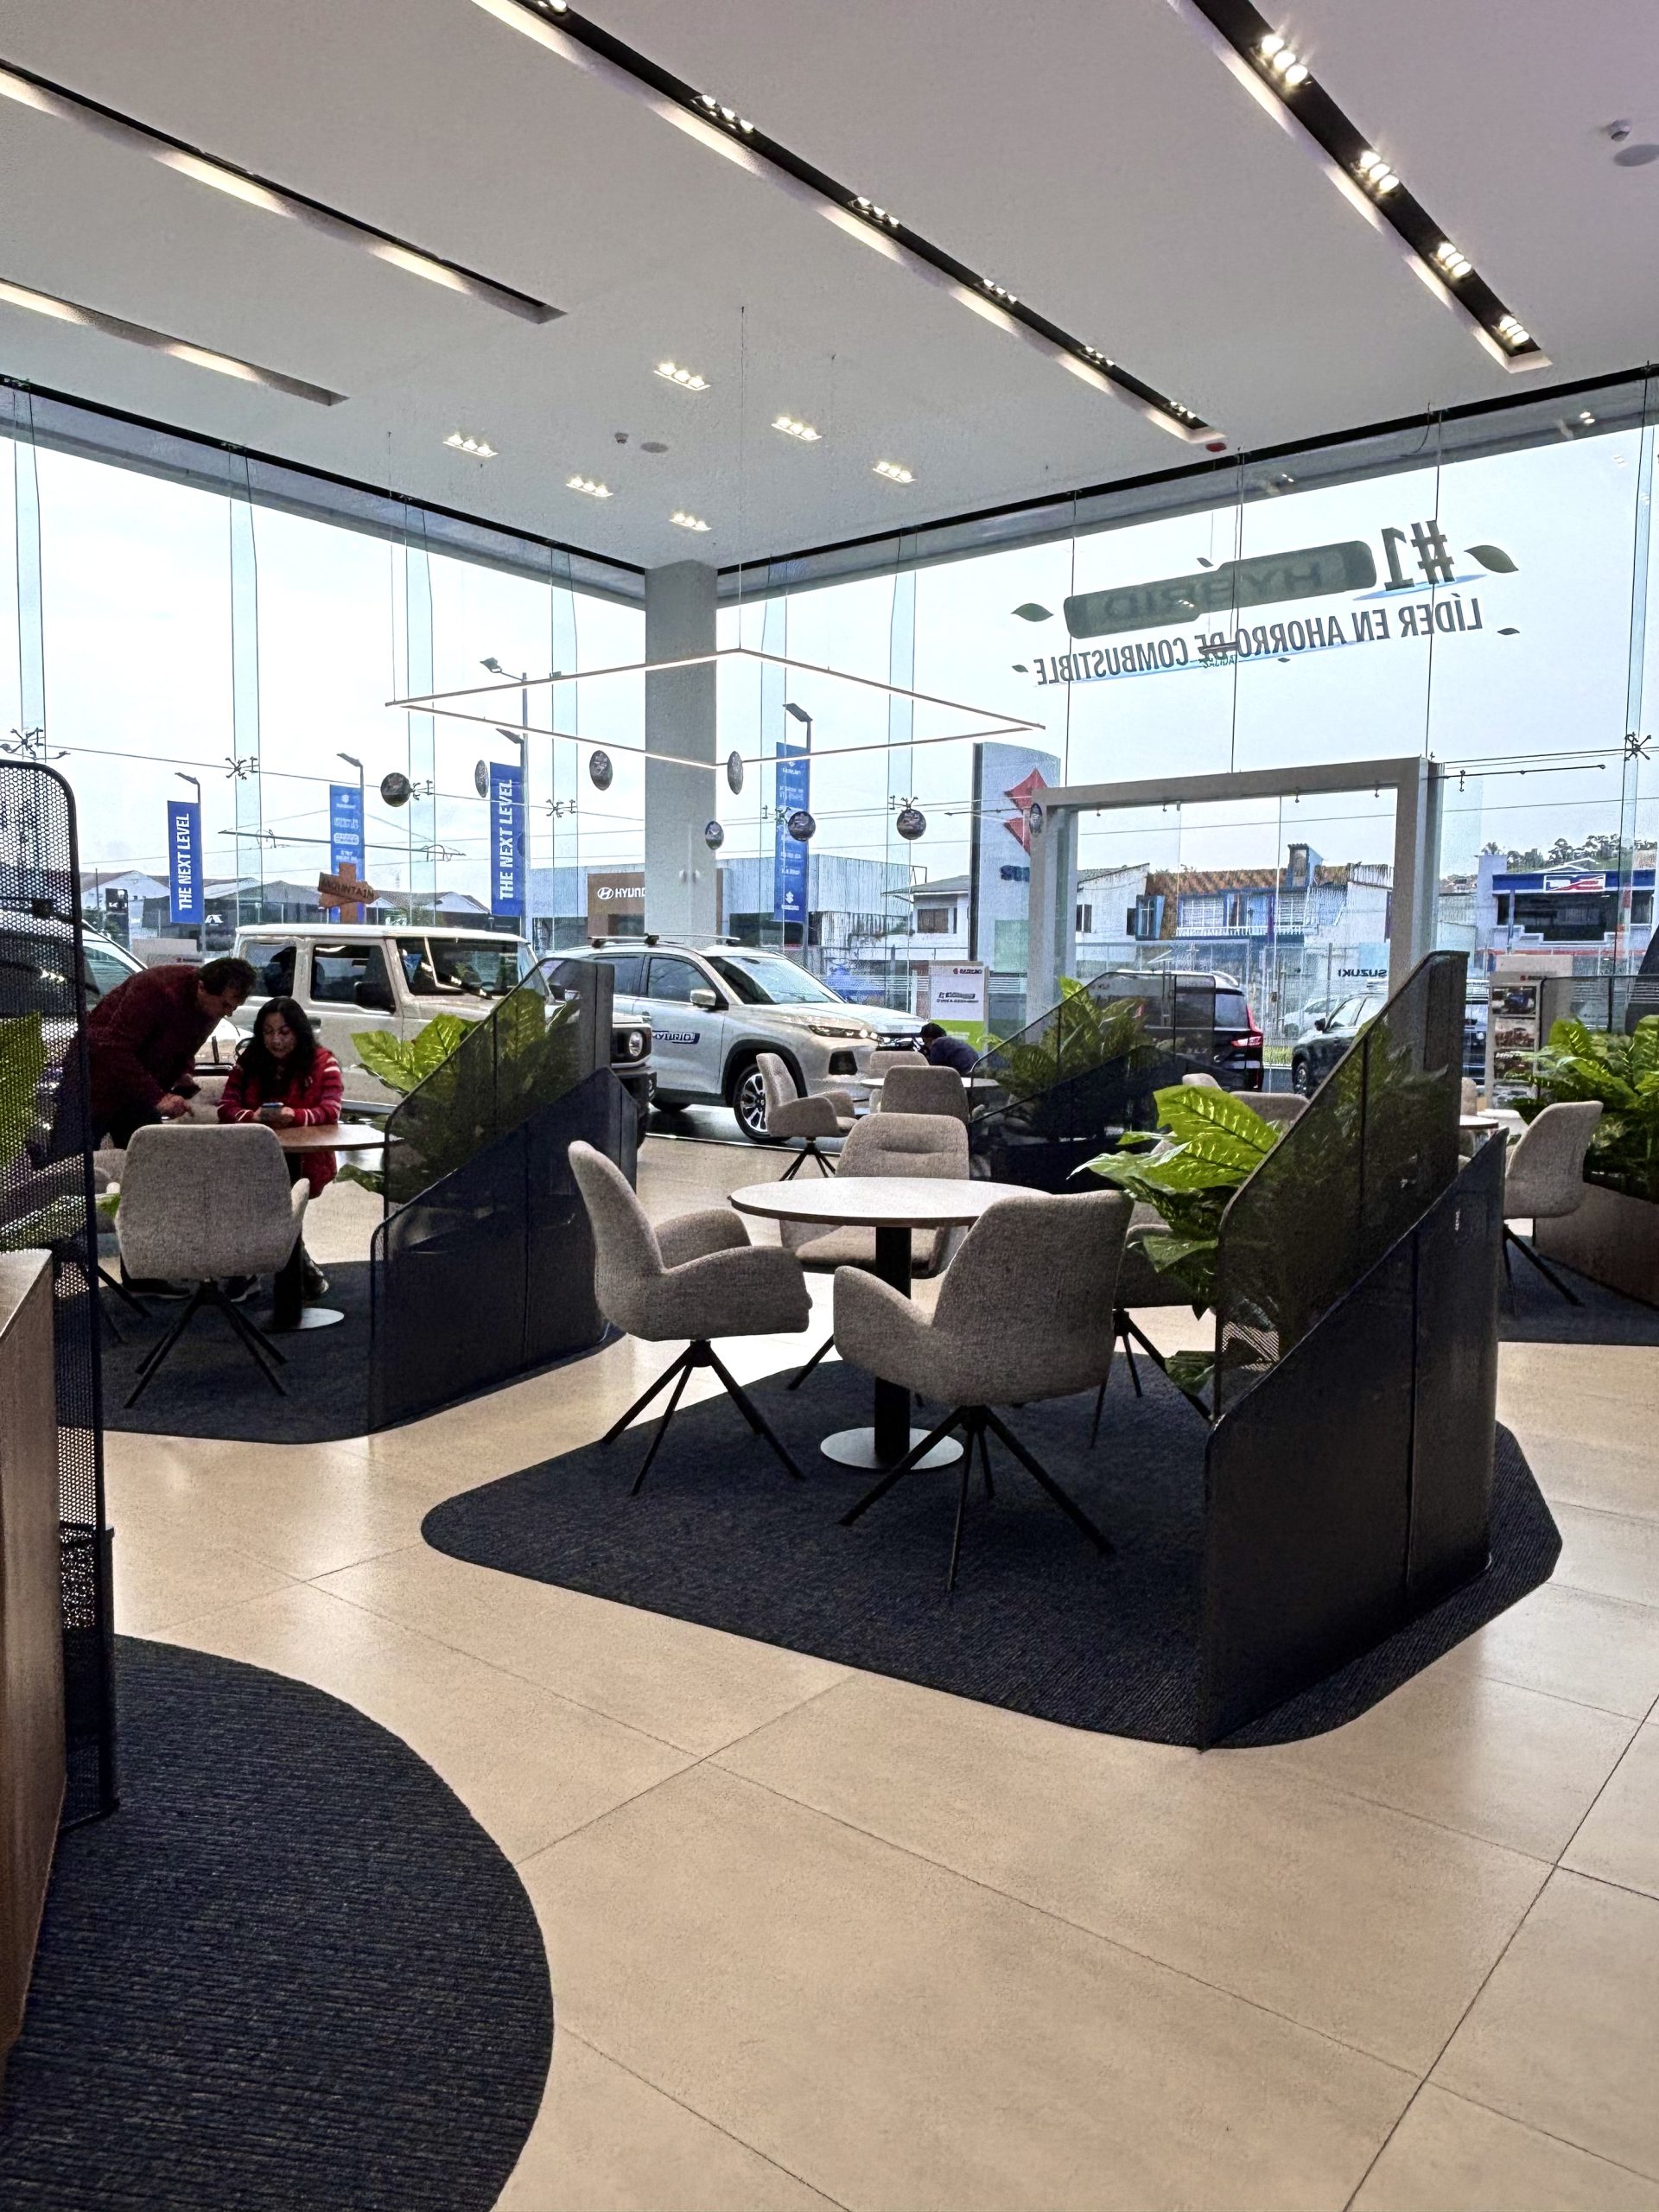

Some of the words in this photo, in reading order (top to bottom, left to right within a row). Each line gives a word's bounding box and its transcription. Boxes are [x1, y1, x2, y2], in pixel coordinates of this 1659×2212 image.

[499, 779, 512, 825] LEVEL
[175, 813, 191, 850] LEVEL
[499, 827, 513, 868] NEXT
[177, 851, 192, 885] NEXT
[178, 887, 193, 911] THE
[499, 871, 514, 900] THE
[614, 887, 645, 899] HYUN
